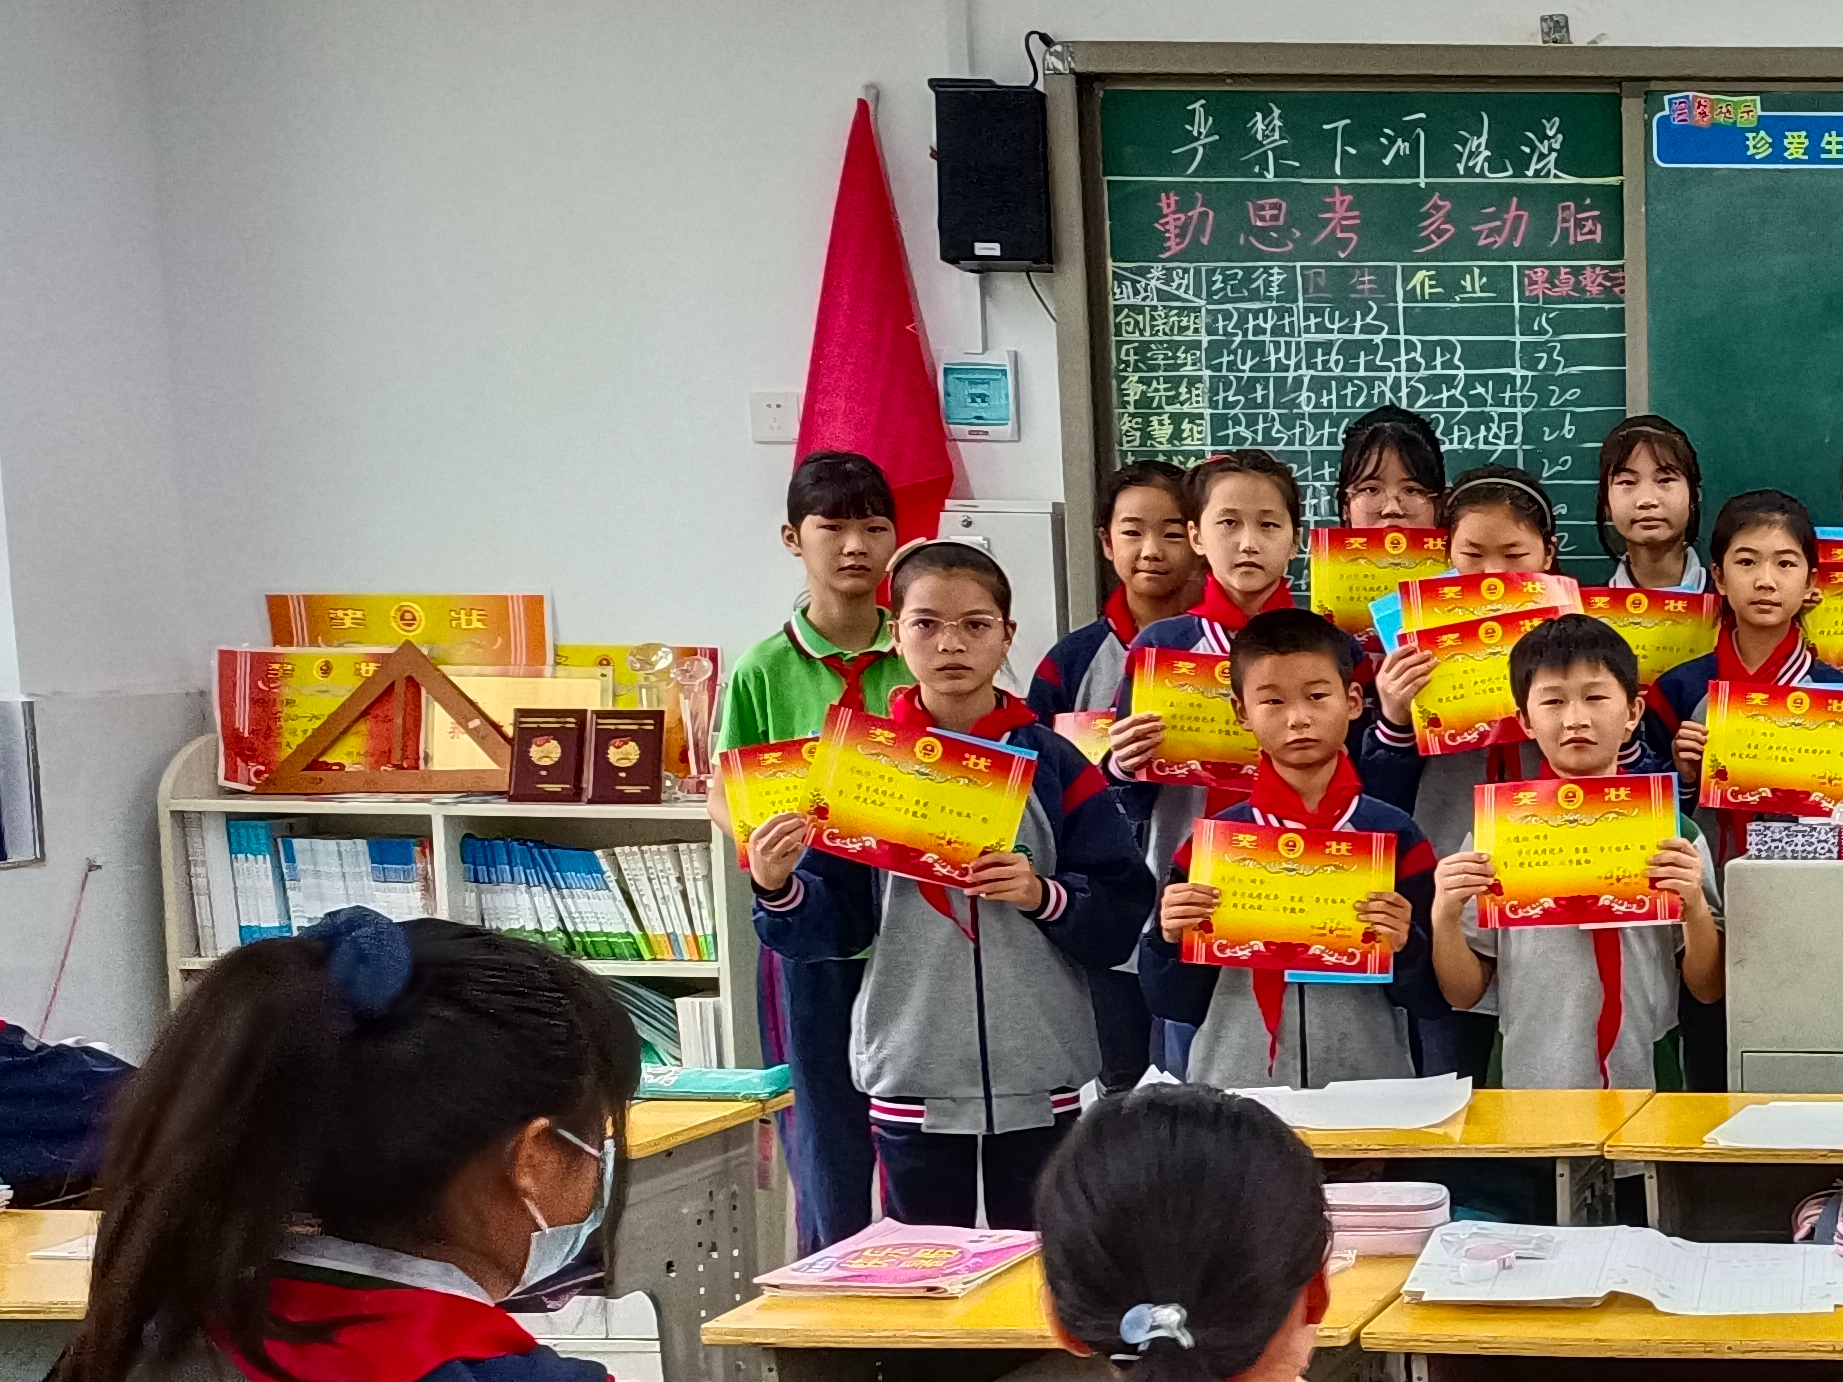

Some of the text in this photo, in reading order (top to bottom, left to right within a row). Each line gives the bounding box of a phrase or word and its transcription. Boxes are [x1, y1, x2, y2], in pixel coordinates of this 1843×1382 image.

[1172, 100, 1574, 187] 严禁下河洗澡
[1153, 186, 1602, 259] 勤思考 多动脑
[1212, 267, 1287, 300] 纪律
[1303, 267, 1386, 299] 卫生
[1406, 267, 1497, 301] 作业
[1115, 306, 1203, 338] 创新组
[1118, 343, 1202, 373] 乐学组
[1120, 375, 1204, 412] 争先组
[1547, 385, 1581, 406] 20
[1119, 413, 1206, 448] 智慧组
[1543, 413, 1576, 441] 26
